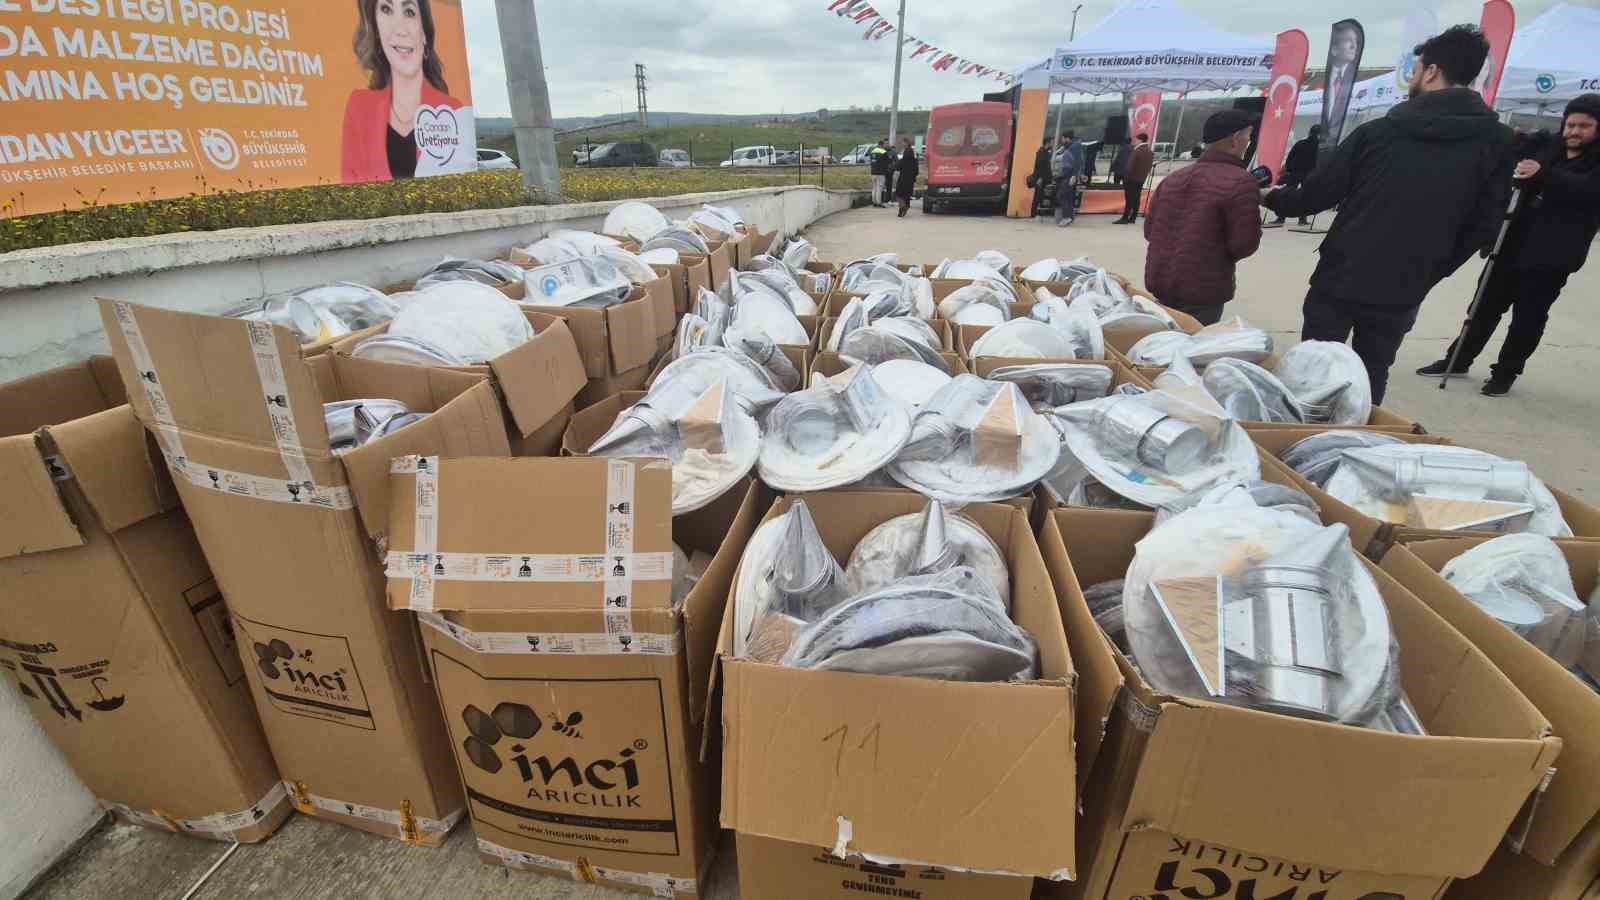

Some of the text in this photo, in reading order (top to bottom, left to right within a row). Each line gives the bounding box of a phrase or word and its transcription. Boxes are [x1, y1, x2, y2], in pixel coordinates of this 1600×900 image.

[52, 26, 218, 66] MALZEME
[220, 39, 324, 77] DAĞITIM
[1080, 53, 1257, 67] T.C. TEKİRDAĞ BÜYÜKŞEHİR BELEDİYESİ
[112, 71, 184, 109] HOŞ
[190, 73, 308, 106] GELDİNİZ
[0, 132, 74, 164] DAN
[284, 661, 346, 692] inci
[511, 743, 640, 790] inci
[527, 787, 641, 808] ARICILIK
[1168, 837, 1343, 884] ARICILIK
